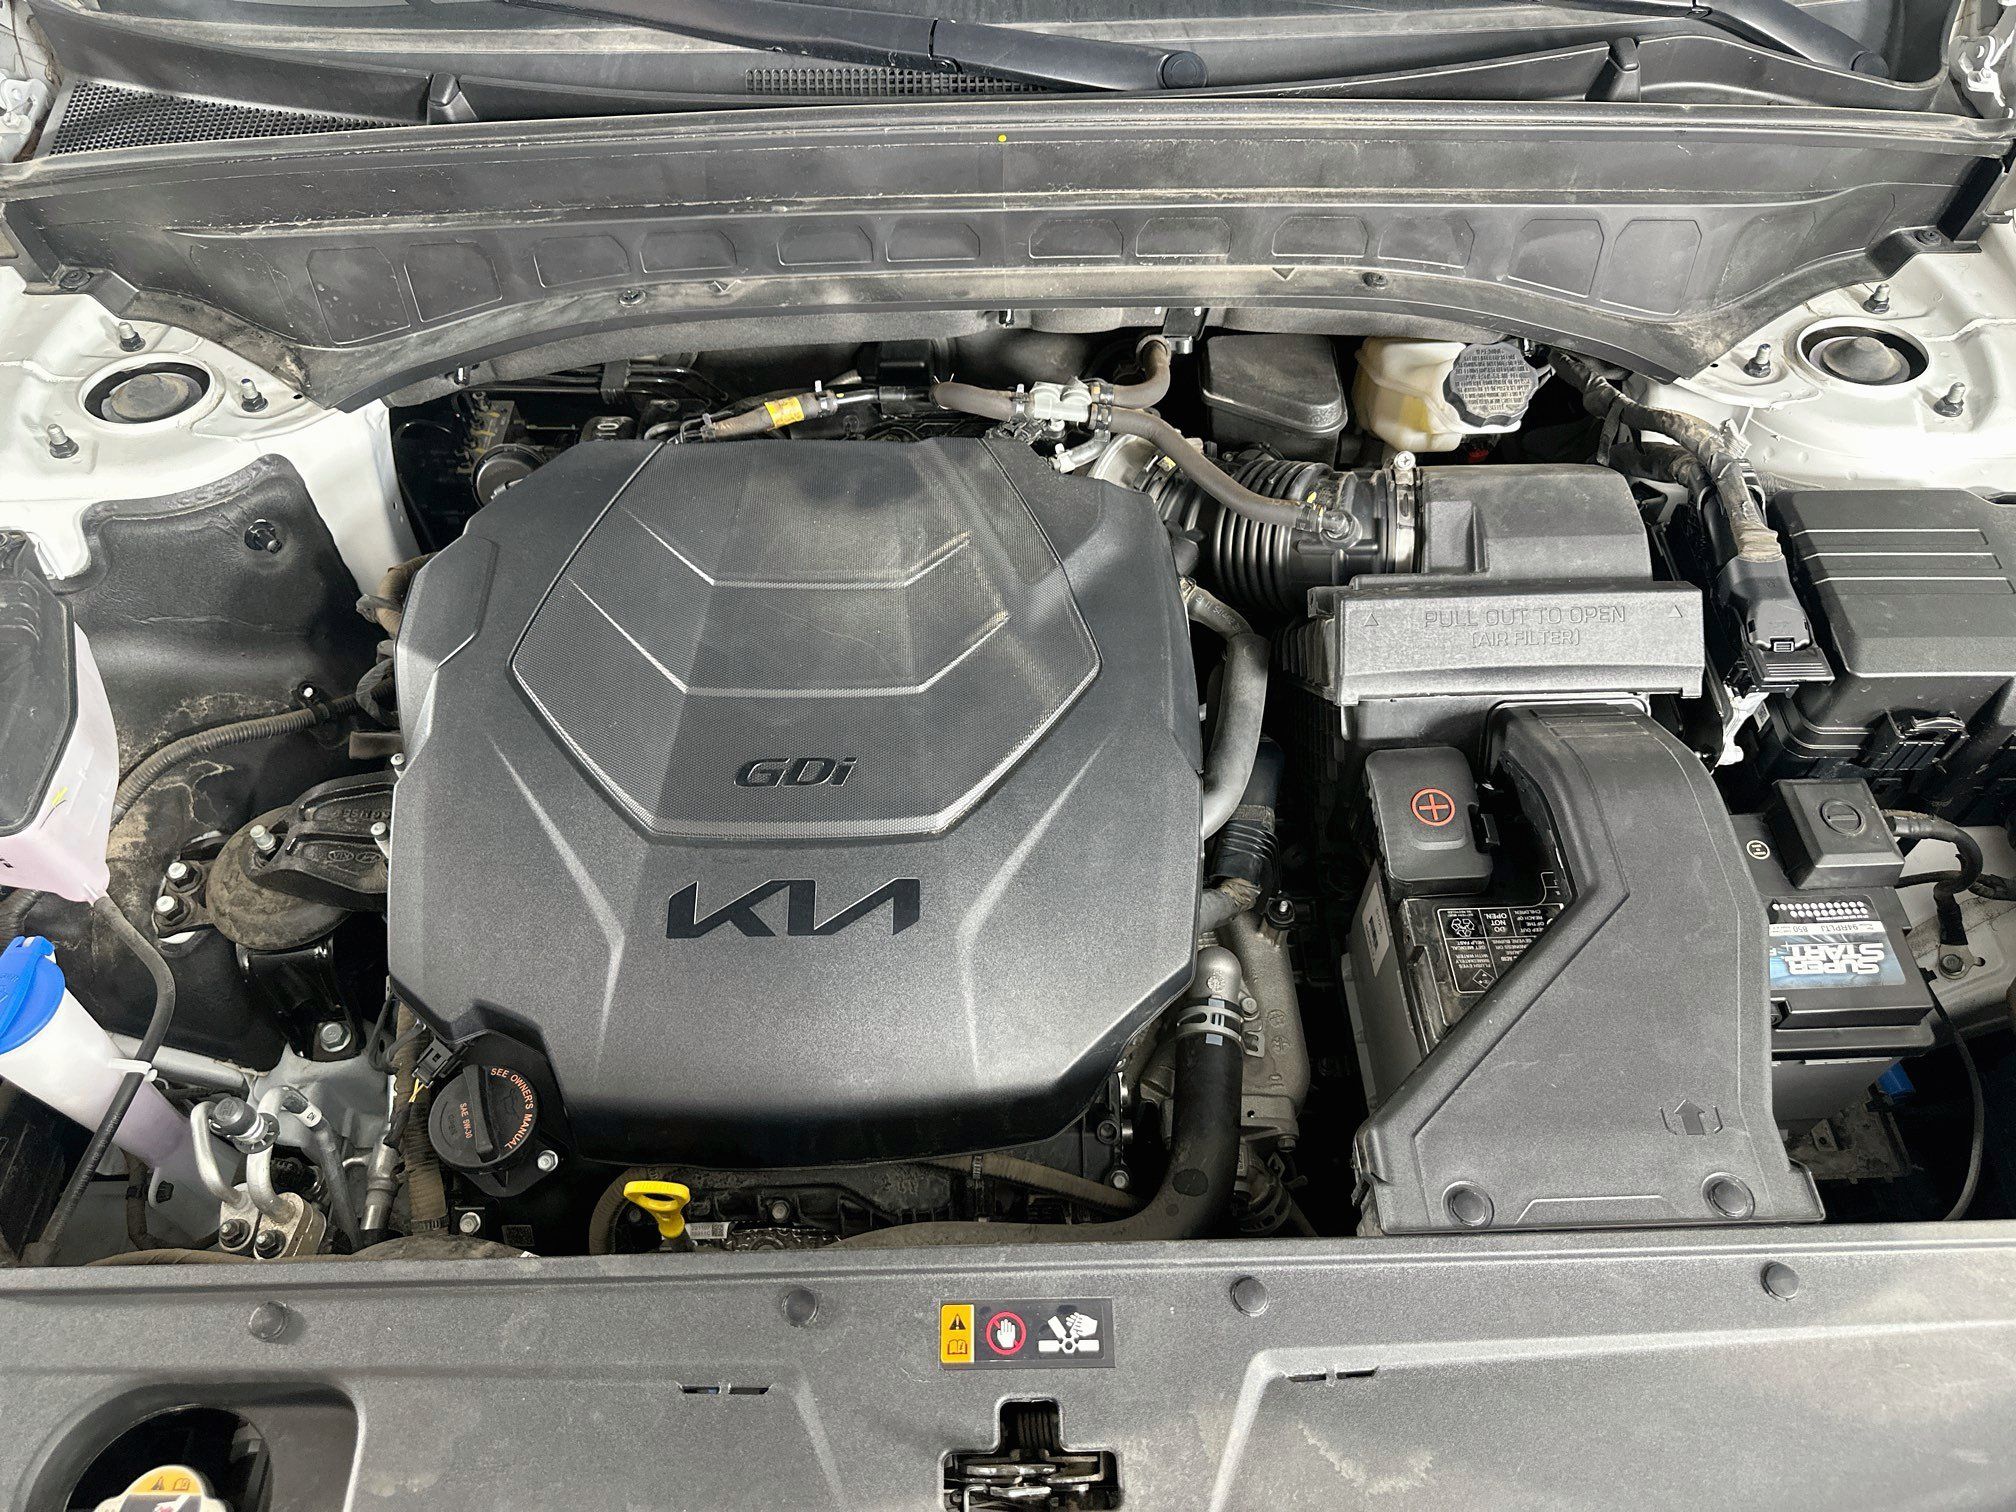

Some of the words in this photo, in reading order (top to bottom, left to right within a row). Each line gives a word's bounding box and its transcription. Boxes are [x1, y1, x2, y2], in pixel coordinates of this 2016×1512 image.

[1424, 610, 1479, 628] PULL
[1485, 608, 1529, 627] OUT
[1537, 607, 1563, 625] TO
[1569, 605, 1626, 624] OPEN
[734, 757, 859, 788] GDi
[666, 877, 921, 939] KIA
[1785, 942, 1885, 961] START
[1785, 957, 1880, 975] SUPER
[490, 1067, 510, 1079] SEE
[510, 1074, 534, 1110] OWNER'S
[459, 1102, 470, 1117] SAE
[504, 1112, 534, 1150] MANUAL
